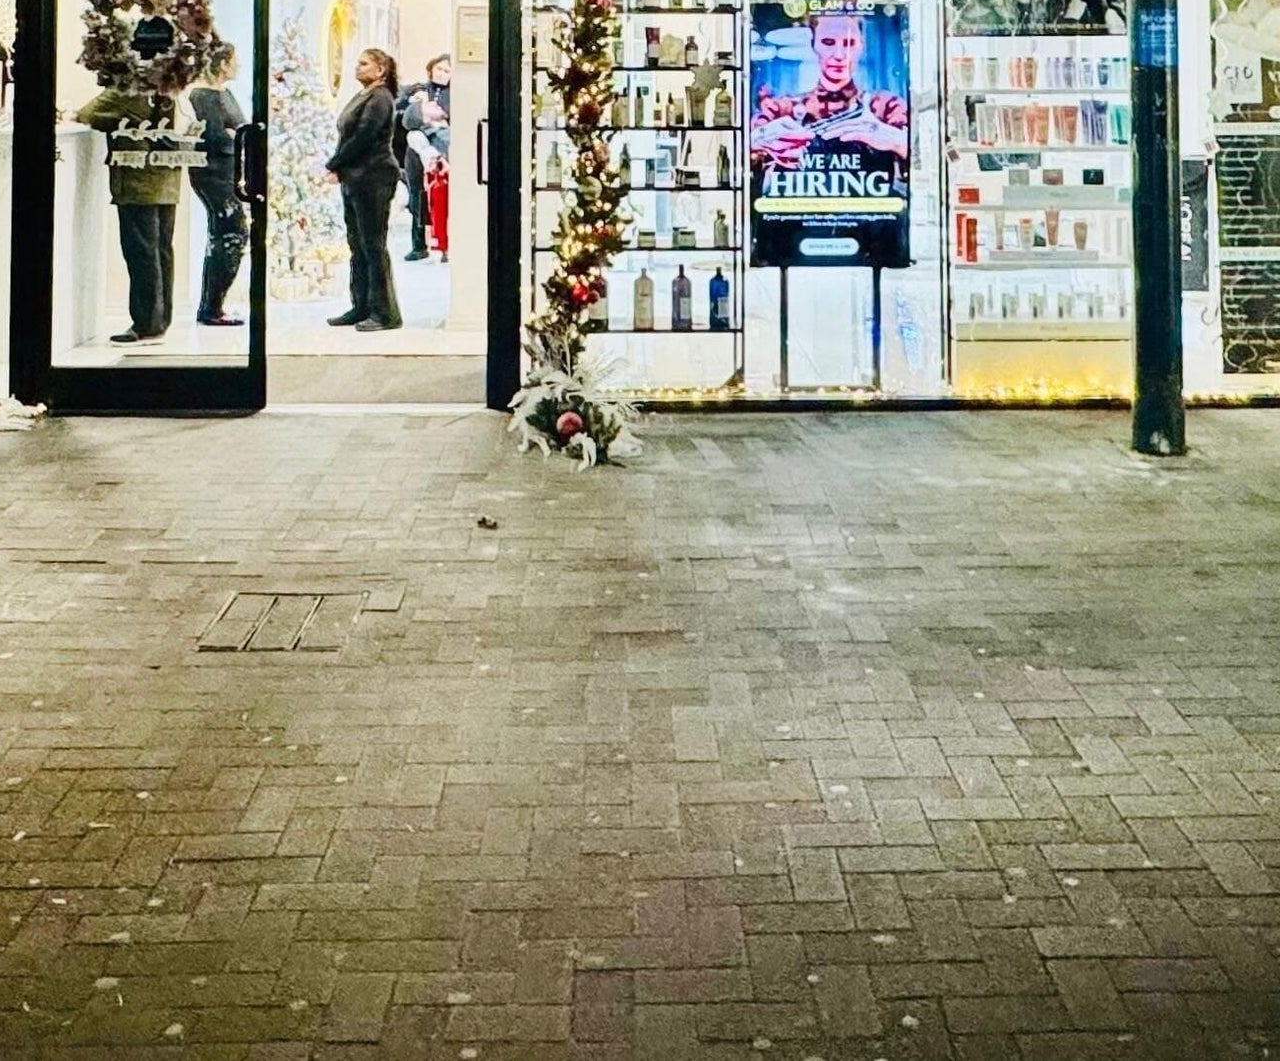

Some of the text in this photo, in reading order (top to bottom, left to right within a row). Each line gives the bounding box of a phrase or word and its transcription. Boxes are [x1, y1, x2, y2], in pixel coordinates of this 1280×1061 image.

[809, 0, 844, 10] GLAM
[857, 0, 876, 10] GO
[800, 154, 861, 169] WE ARE
[769, 171, 890, 197] HIRING
